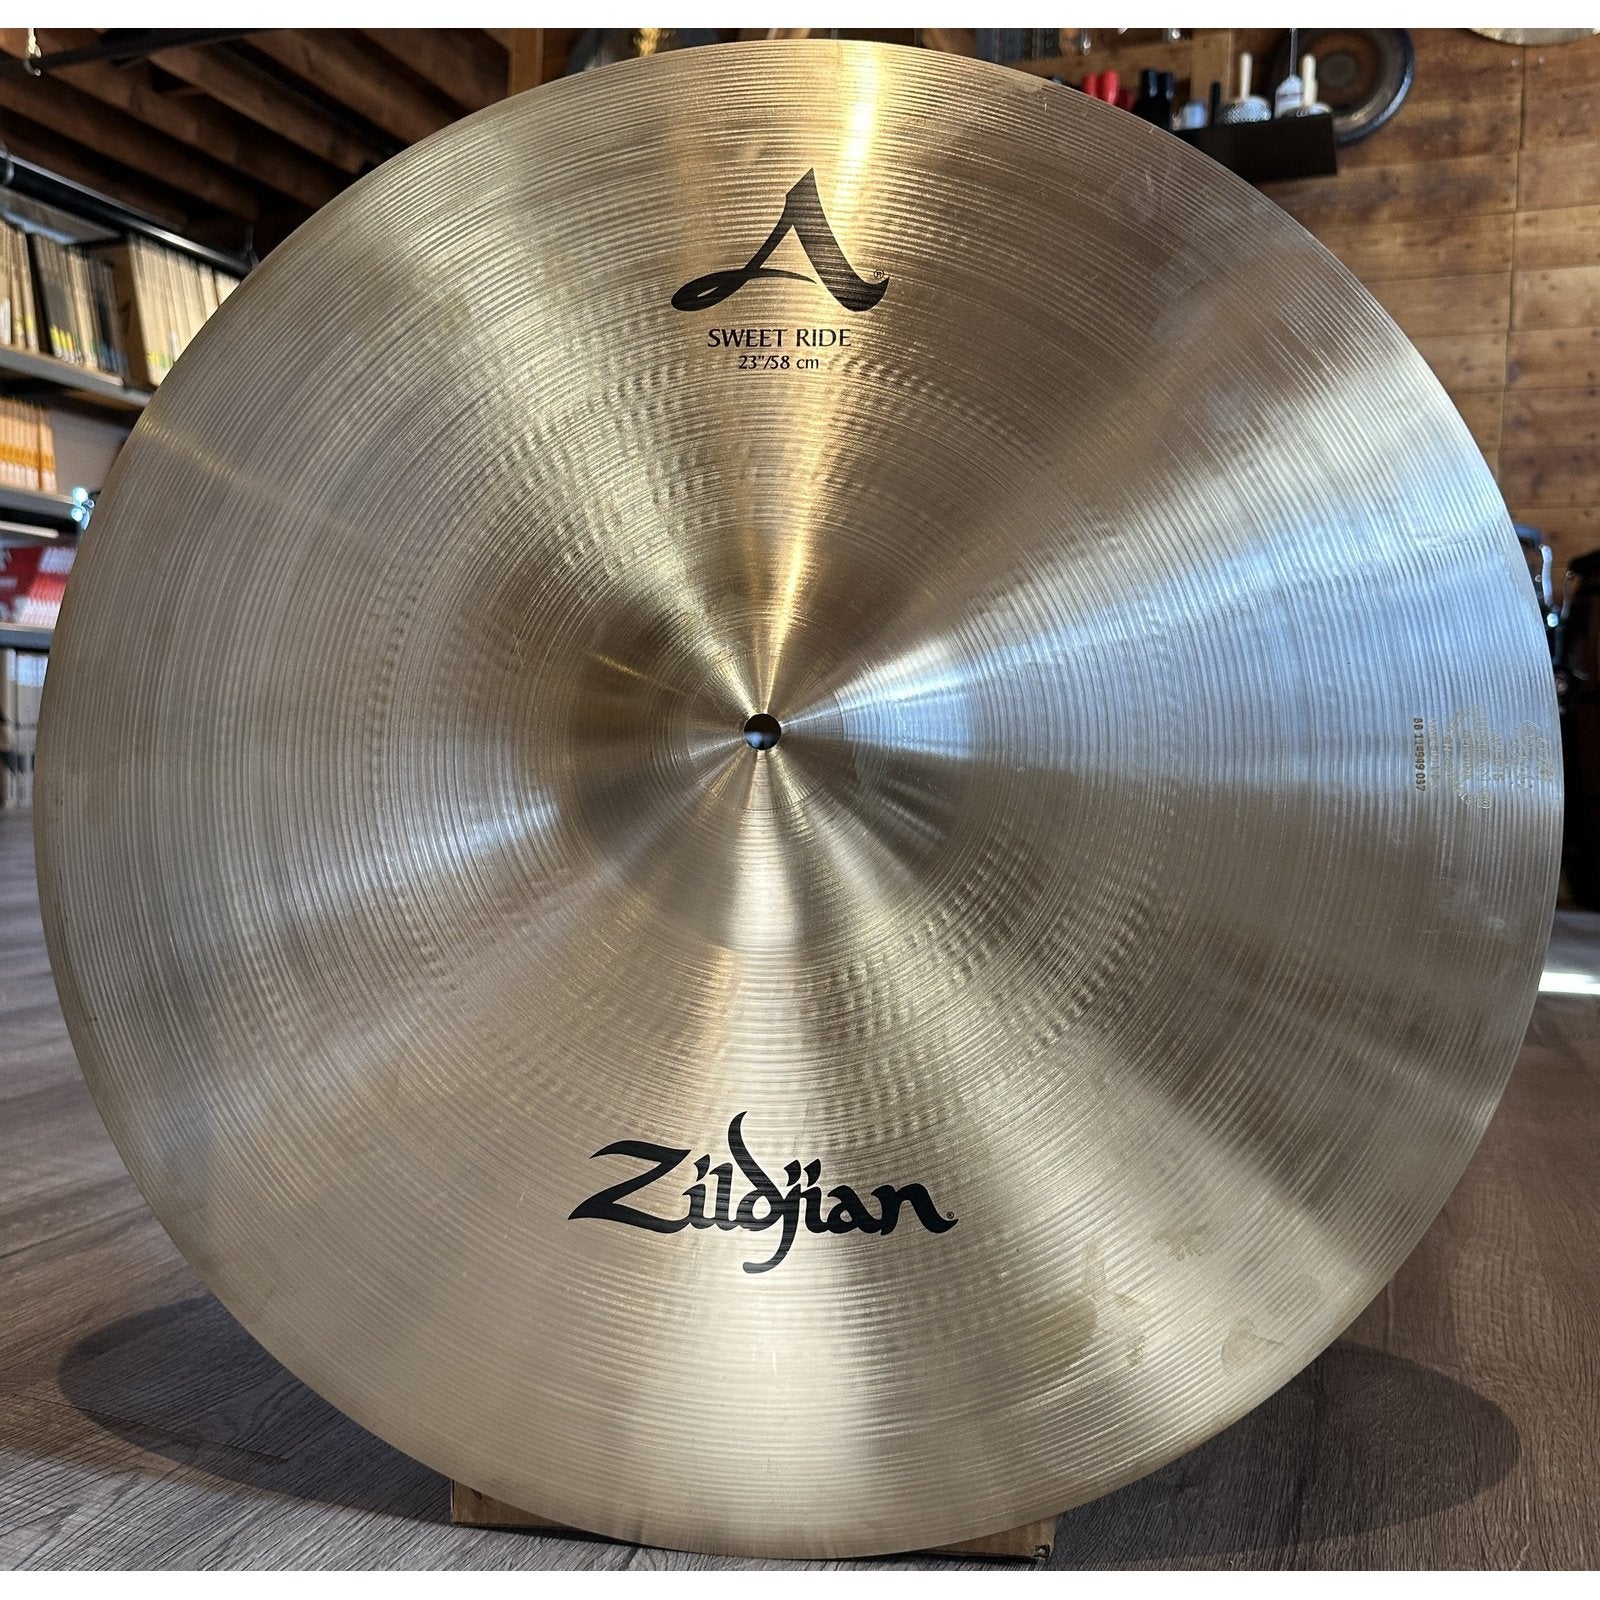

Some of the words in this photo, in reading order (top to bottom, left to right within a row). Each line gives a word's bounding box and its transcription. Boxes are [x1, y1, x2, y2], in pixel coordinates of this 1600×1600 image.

[671, 167, 890, 312] A
[707, 328, 788, 348] SWEET
[796, 328, 852, 347] RIDE
[796, 358, 819, 370] cm
[1415, 772, 1426, 792] 037
[567, 1110, 959, 1274] Zildjian
